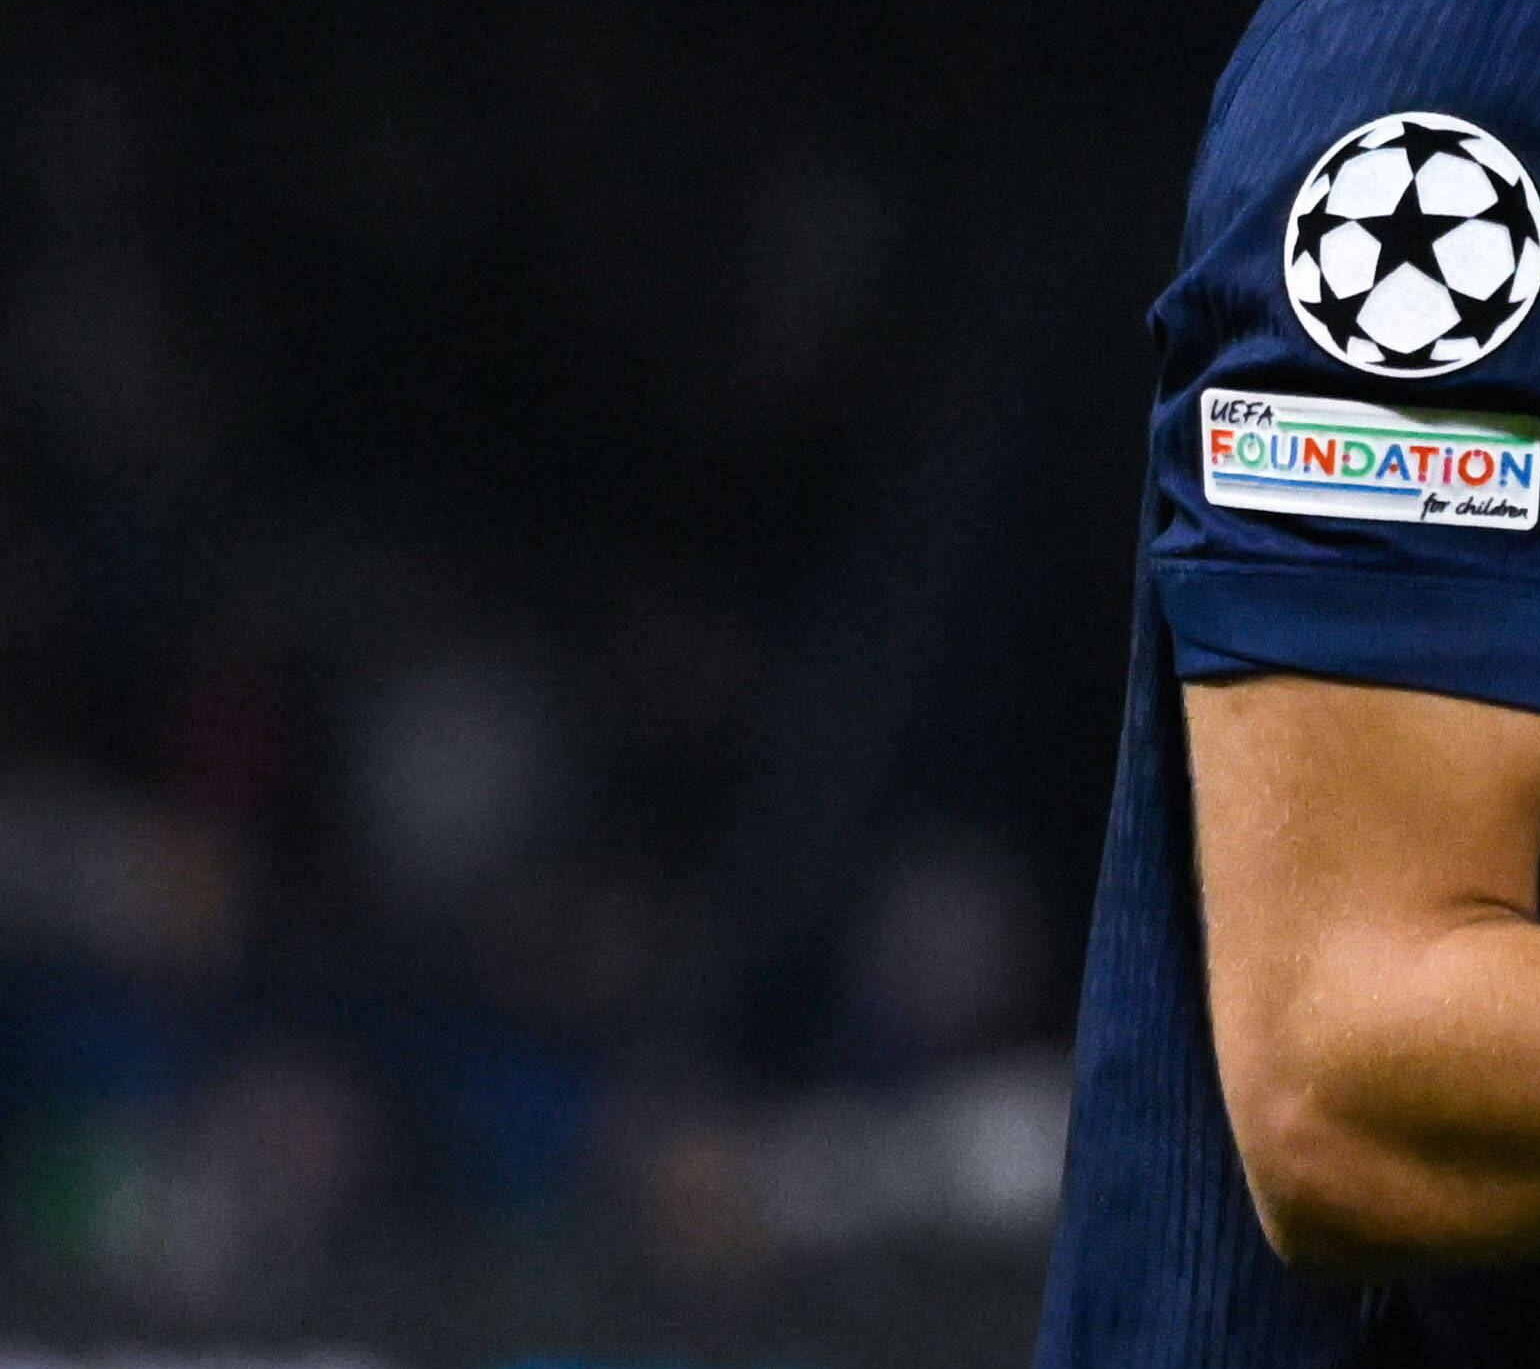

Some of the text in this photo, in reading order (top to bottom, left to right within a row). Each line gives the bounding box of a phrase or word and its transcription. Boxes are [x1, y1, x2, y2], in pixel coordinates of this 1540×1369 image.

[1211, 398, 1274, 427] UEFA
[1420, 492, 1529, 521] for children
